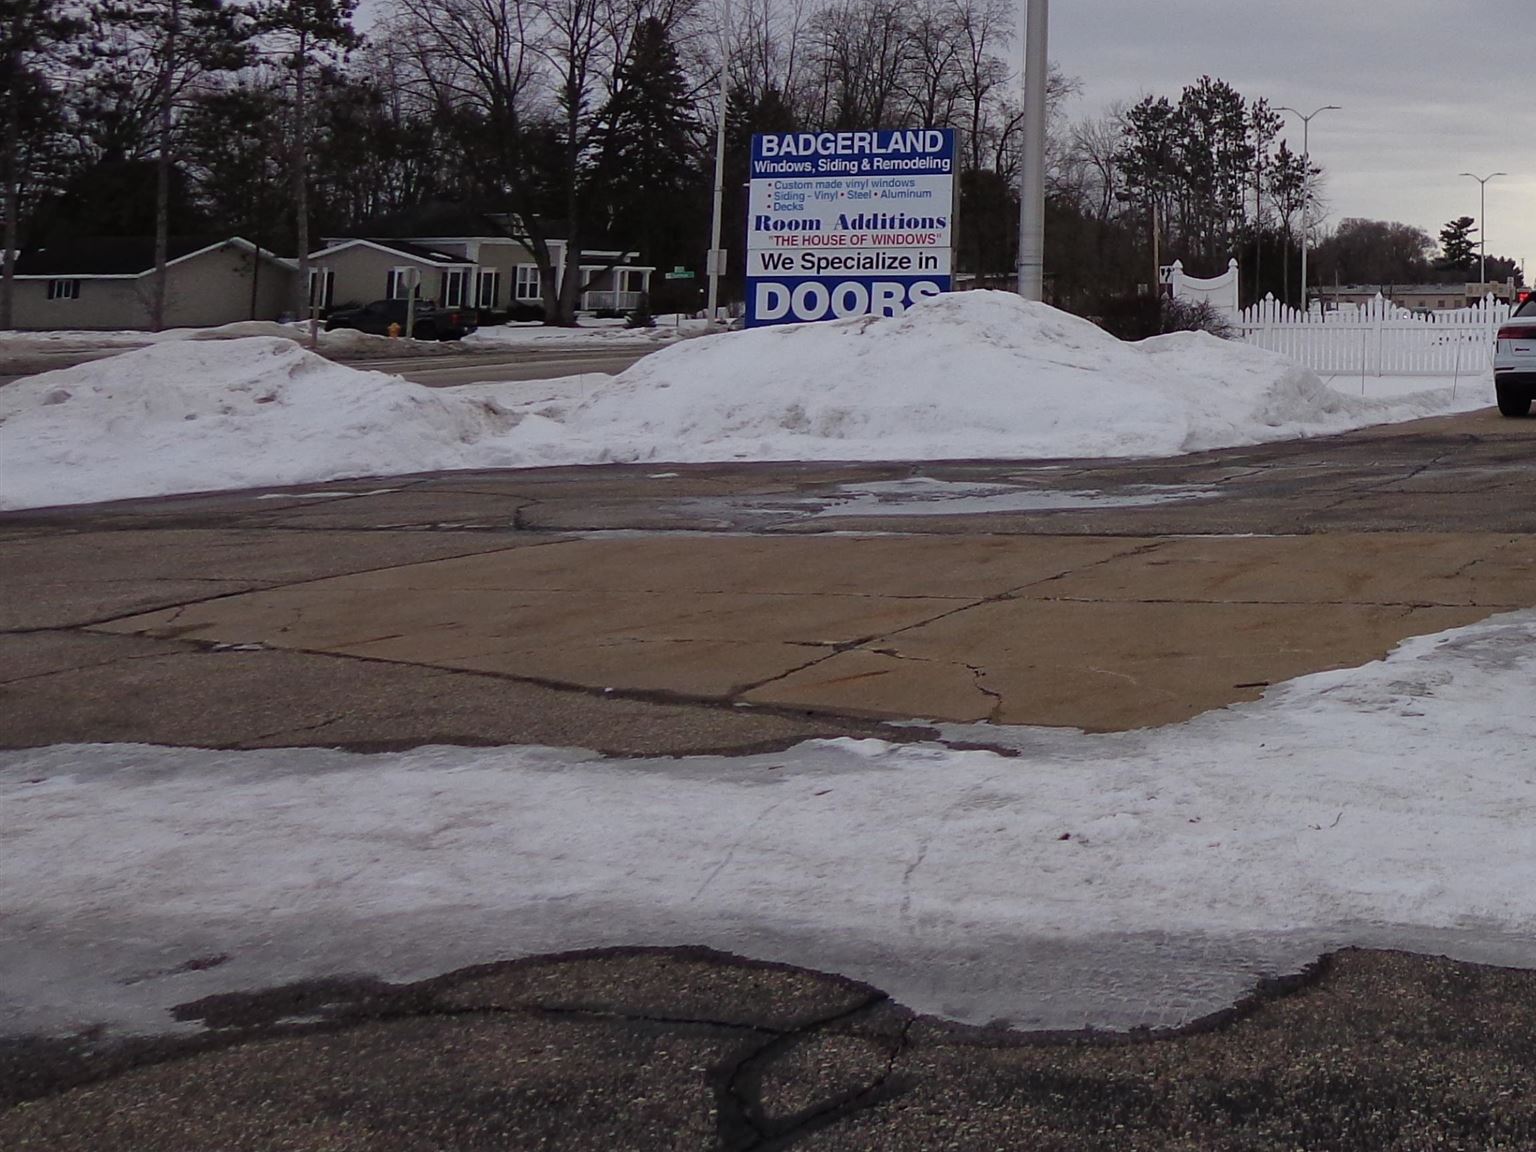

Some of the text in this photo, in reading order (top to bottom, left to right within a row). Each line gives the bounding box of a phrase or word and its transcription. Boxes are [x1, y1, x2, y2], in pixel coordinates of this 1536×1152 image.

[761, 130, 944, 157] BADGERLAND
[754, 156, 951, 174] Windows, Siding & Remodeling
[774, 178, 916, 190] Custom made vinyl windows
[773, 191, 805, 202] Siding
[814, 190, 838, 201] Vinyl
[847, 189, 872, 200] Steel
[880, 189, 932, 199] Aluminum
[773, 202, 804, 212] Decks
[754, 212, 947, 232] Room Additions
[802, 234, 847, 246] HOUSE
[849, 234, 868, 246] OF
[760, 251, 938, 275] We Specialize in
